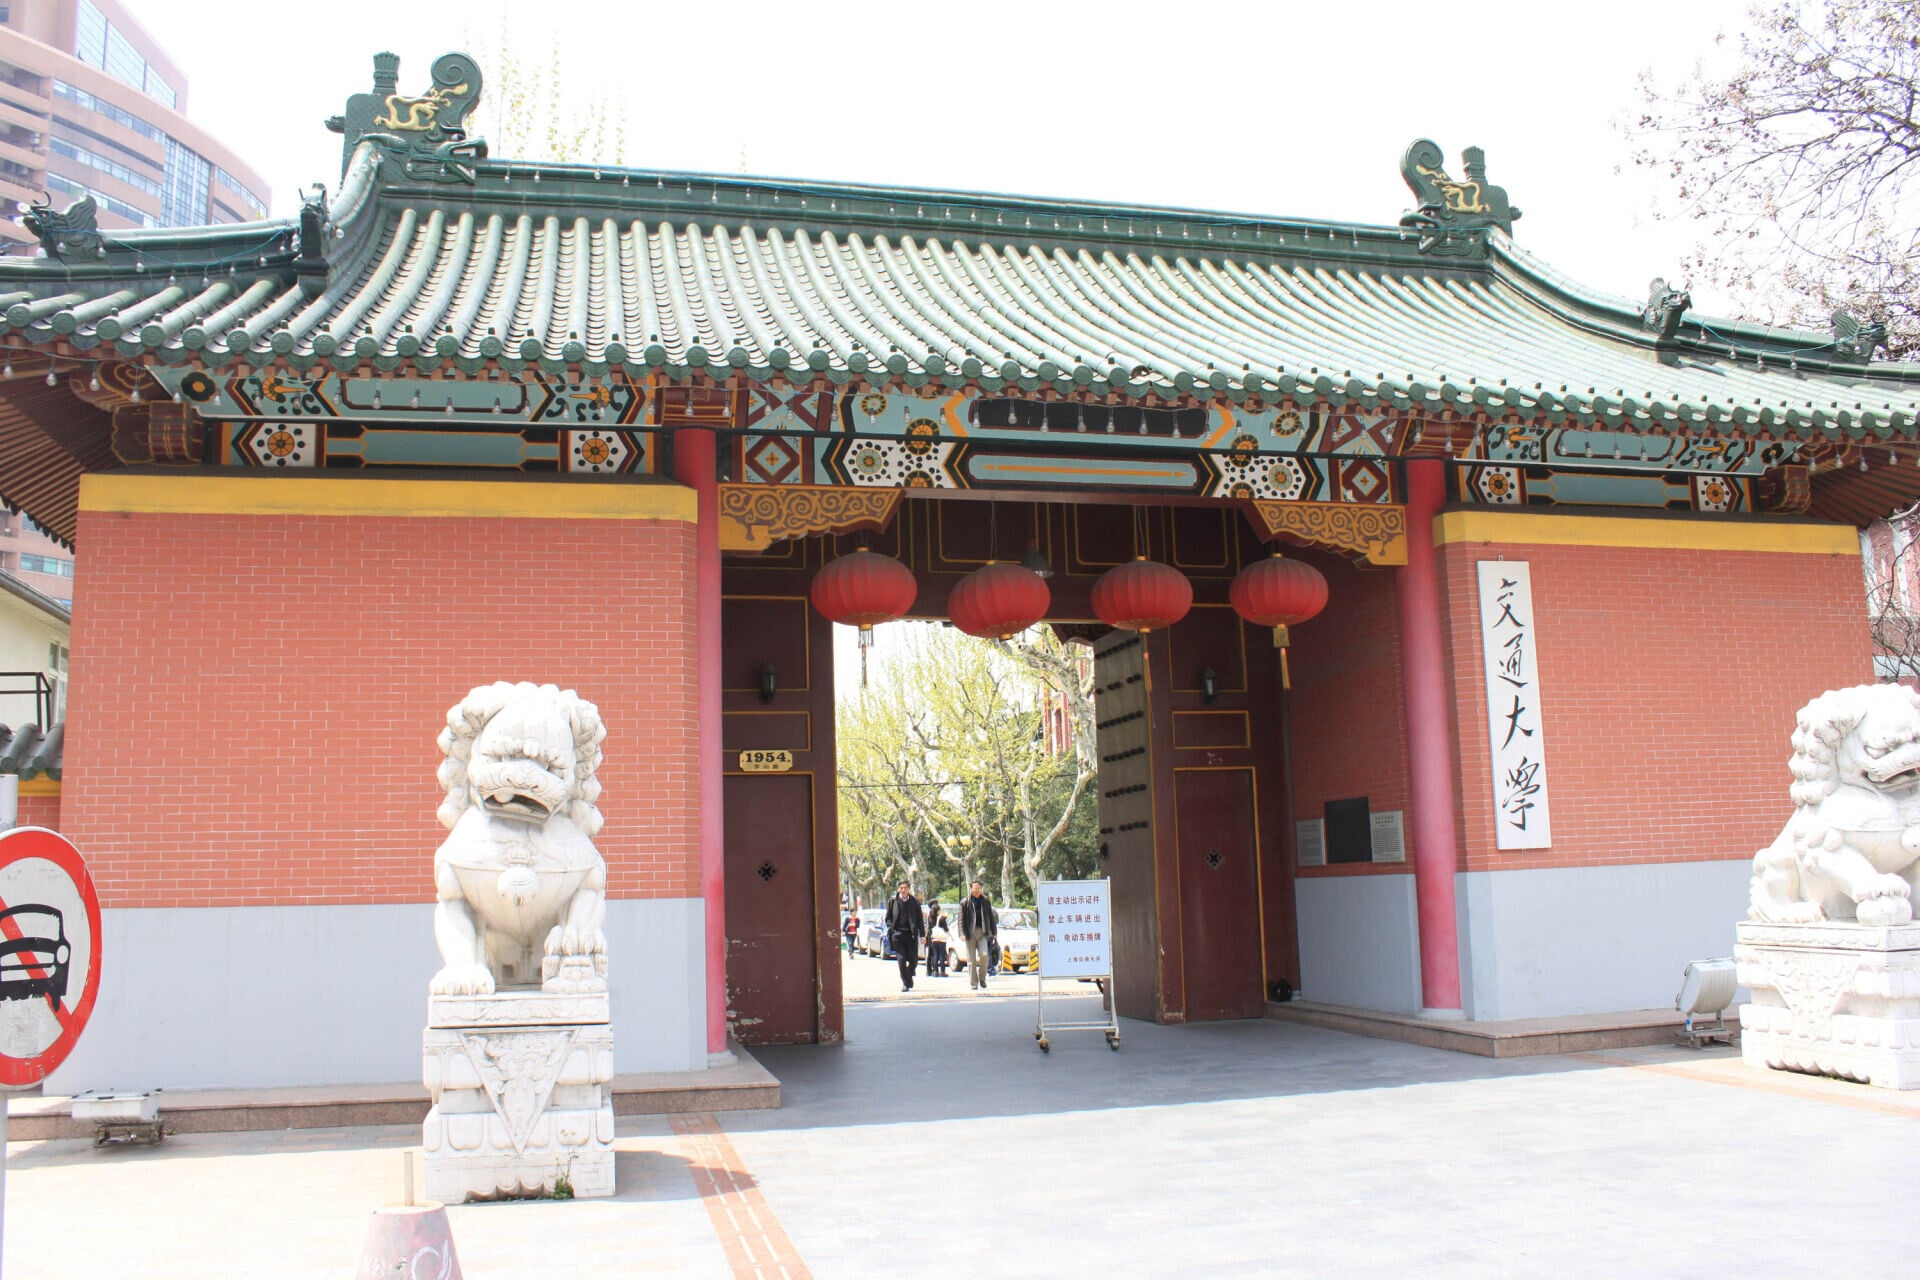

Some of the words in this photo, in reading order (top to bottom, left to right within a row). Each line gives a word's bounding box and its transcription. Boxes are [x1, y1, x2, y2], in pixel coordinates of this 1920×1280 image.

[745, 752, 786, 763] 1954
[1047, 895, 1100, 905] 请主动出示证件
[1048, 914, 1101, 924] 禁止车辆进出
